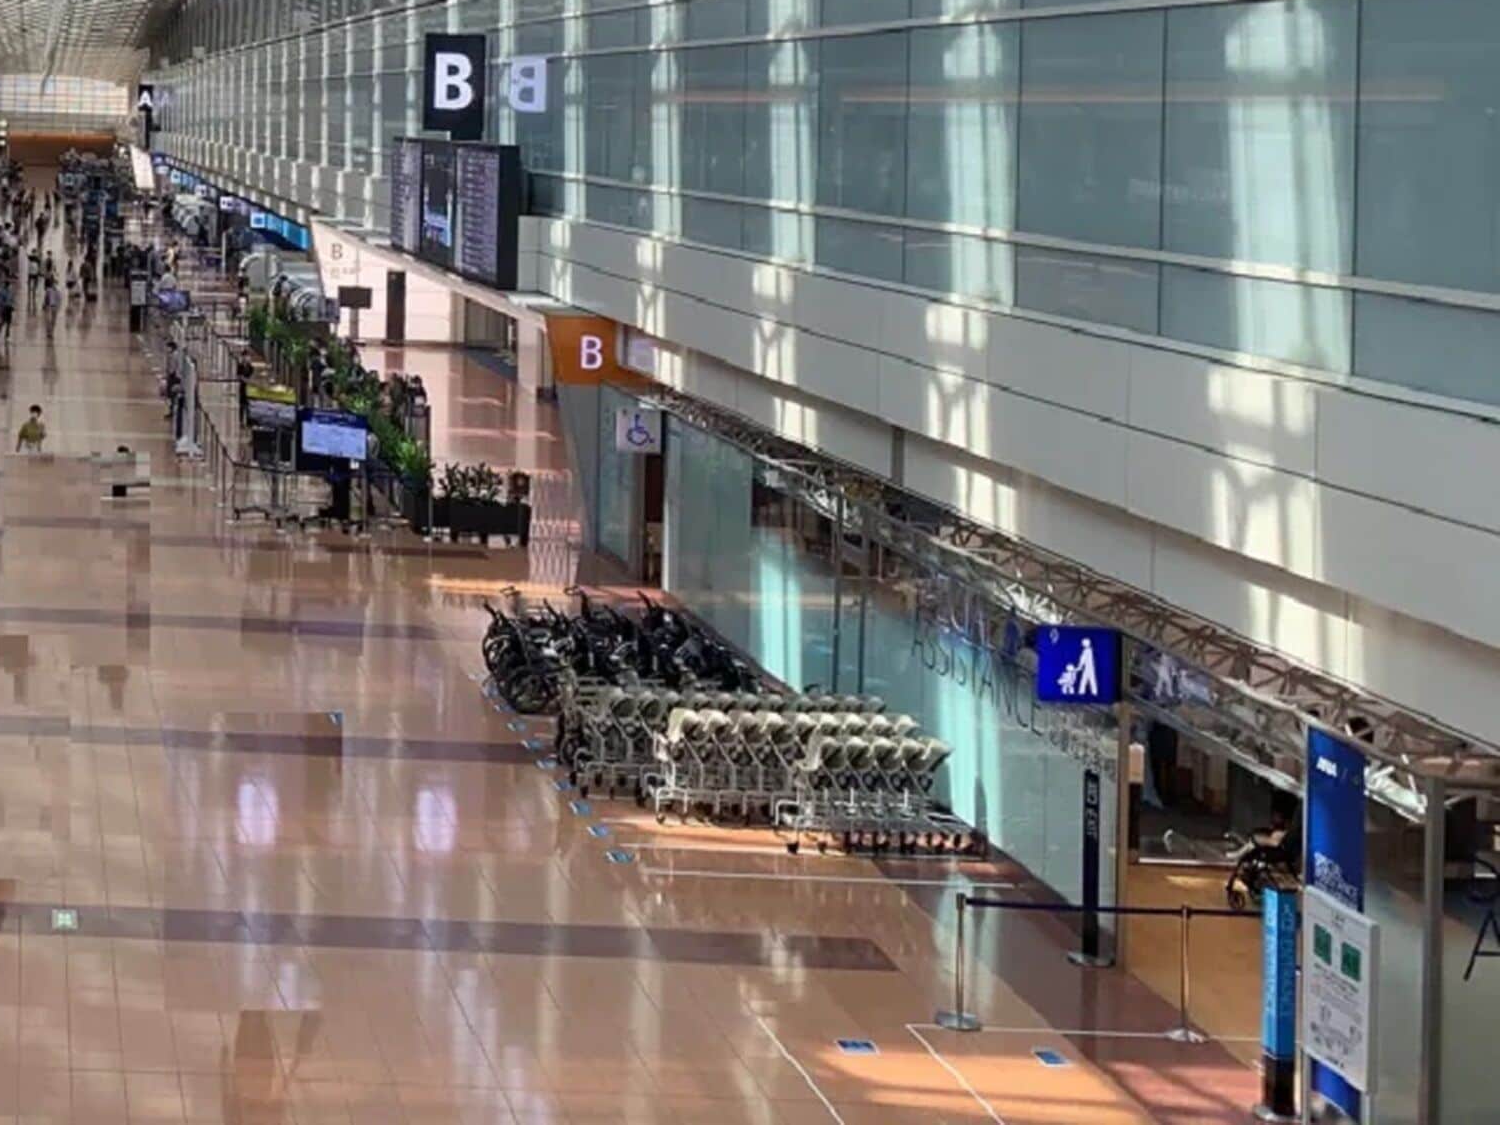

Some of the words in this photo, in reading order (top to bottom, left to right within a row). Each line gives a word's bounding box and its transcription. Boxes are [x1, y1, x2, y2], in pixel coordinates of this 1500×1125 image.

[433, 52, 474, 110] B
[139, 90, 153, 106] A
[331, 243, 343, 260] B
[581, 335, 603, 369] B
